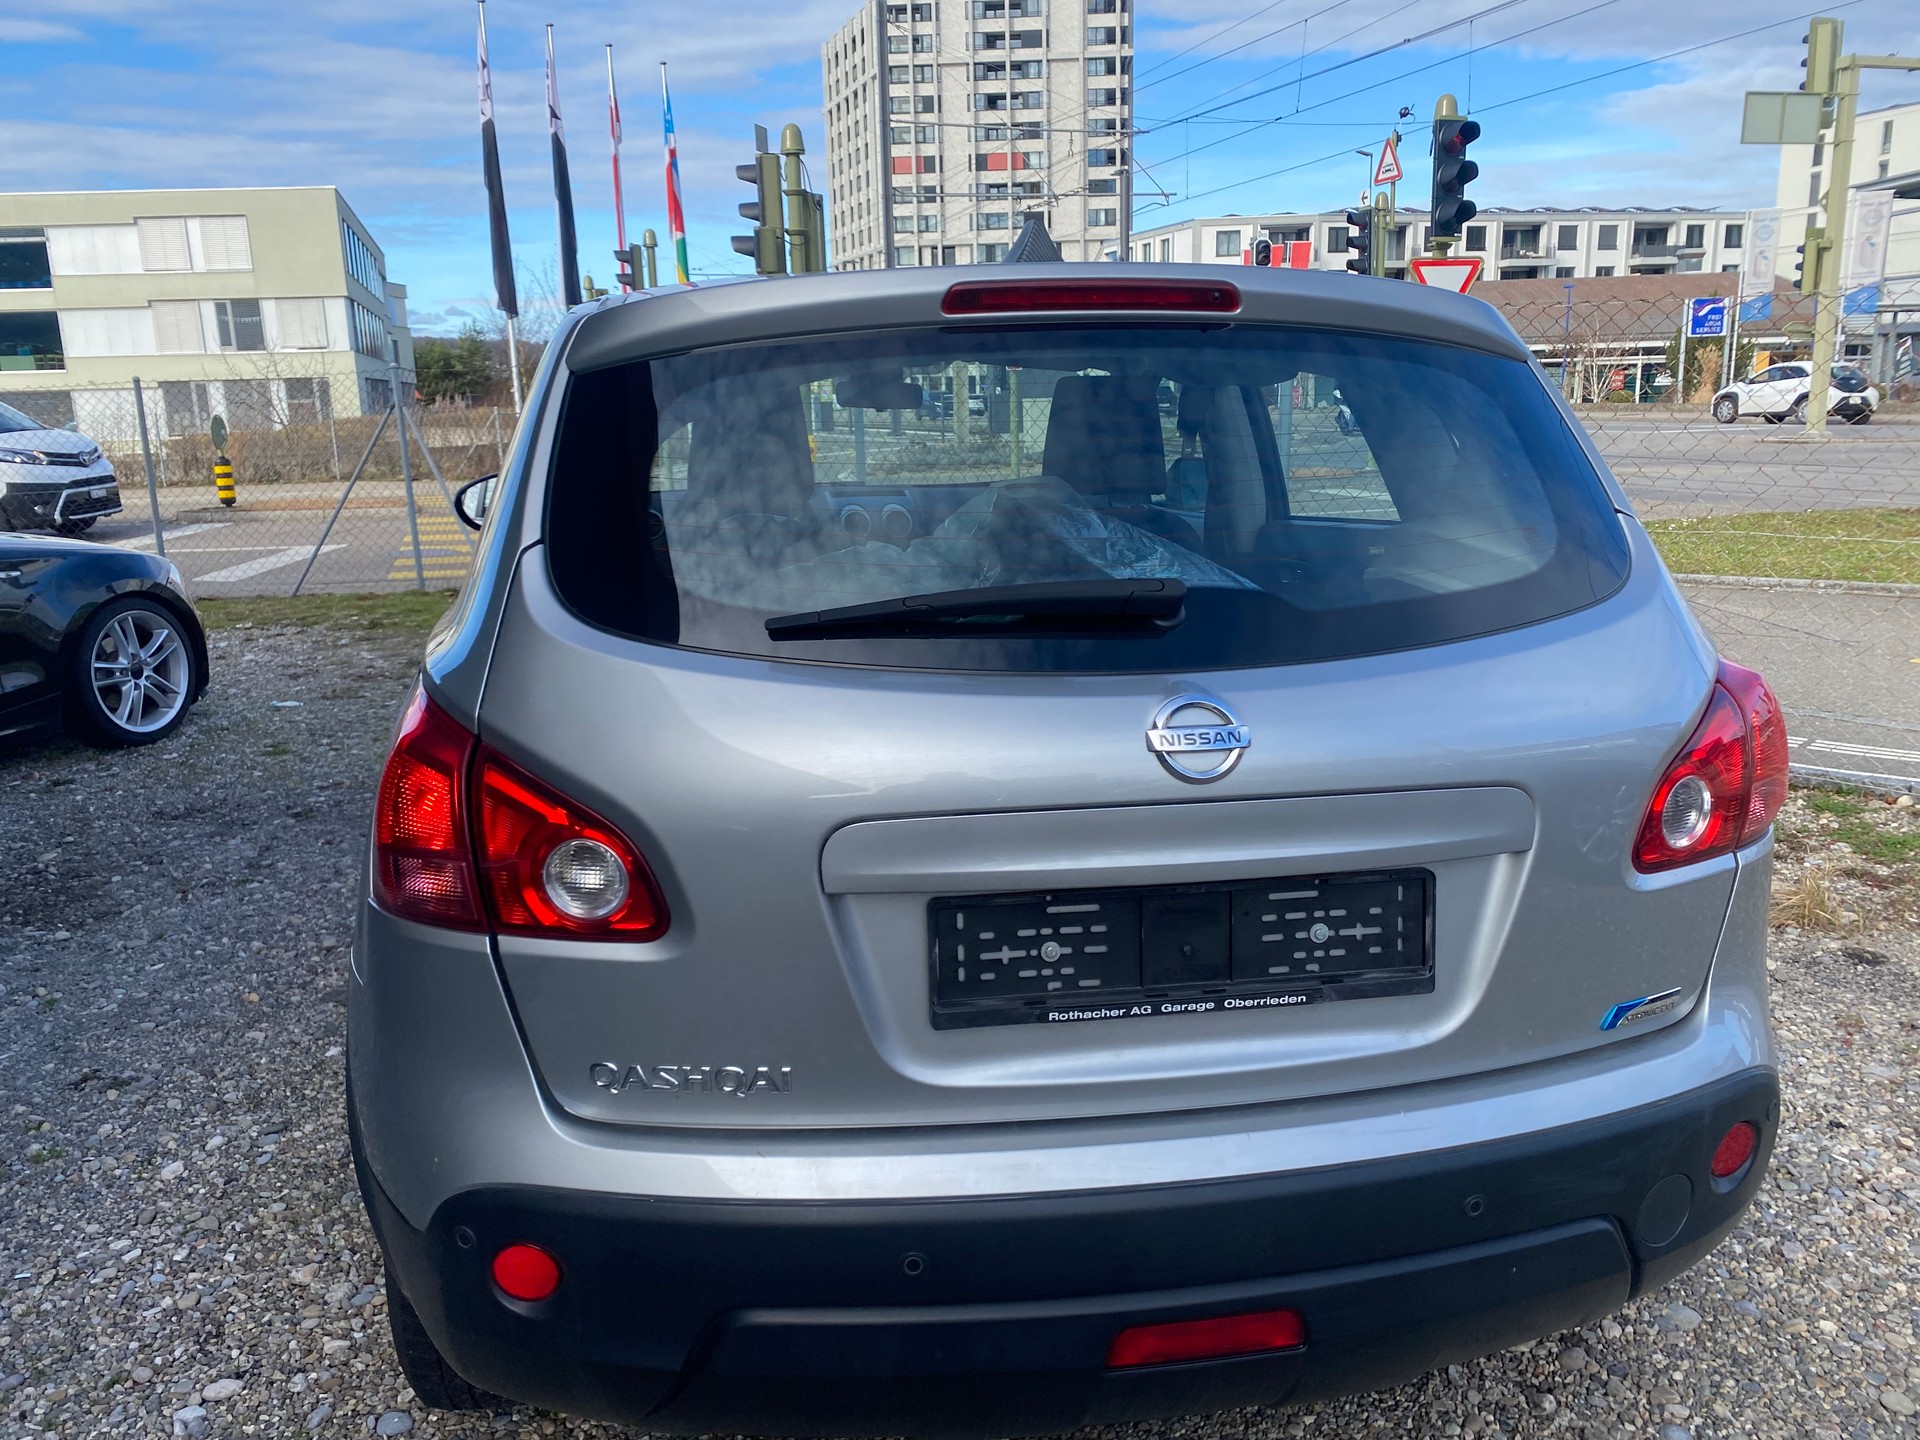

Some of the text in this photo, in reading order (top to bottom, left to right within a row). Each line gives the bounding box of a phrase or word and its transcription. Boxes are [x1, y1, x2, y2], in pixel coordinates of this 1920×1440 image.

[1695, 326, 1721, 334] SERVICE
[1159, 731, 1242, 747] NISSAN
[1048, 994, 1307, 1021] Rothacher AG Garage Oberrieden
[589, 1061, 793, 1097] QASHQAI
